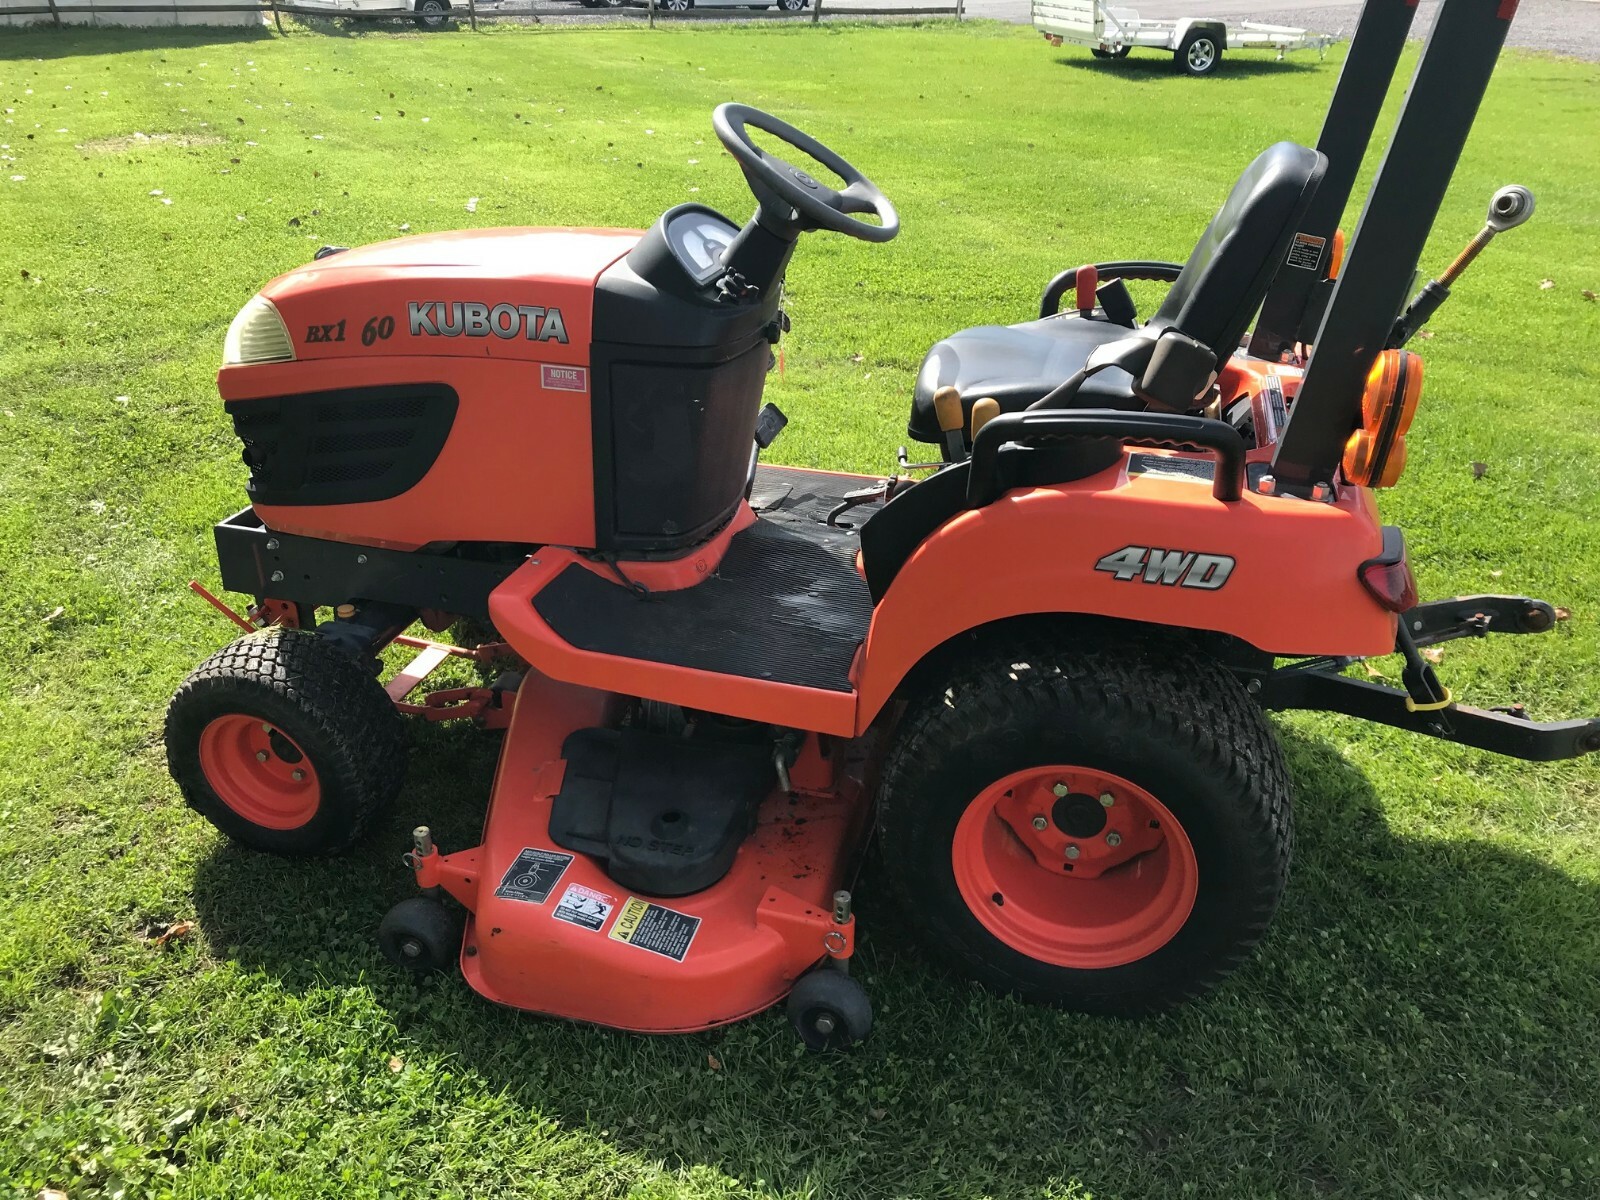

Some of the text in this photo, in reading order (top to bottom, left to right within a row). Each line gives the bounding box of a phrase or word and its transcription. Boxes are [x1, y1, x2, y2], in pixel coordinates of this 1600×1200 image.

[361, 315, 396, 346] 60
[408, 302, 569, 344] KUBOTA
[550, 368, 577, 380] NOTICE
[1095, 545, 1236, 591] 4WD
[615, 835, 695, 856] NO STEP
[620, 900, 646, 930] CAUTION
